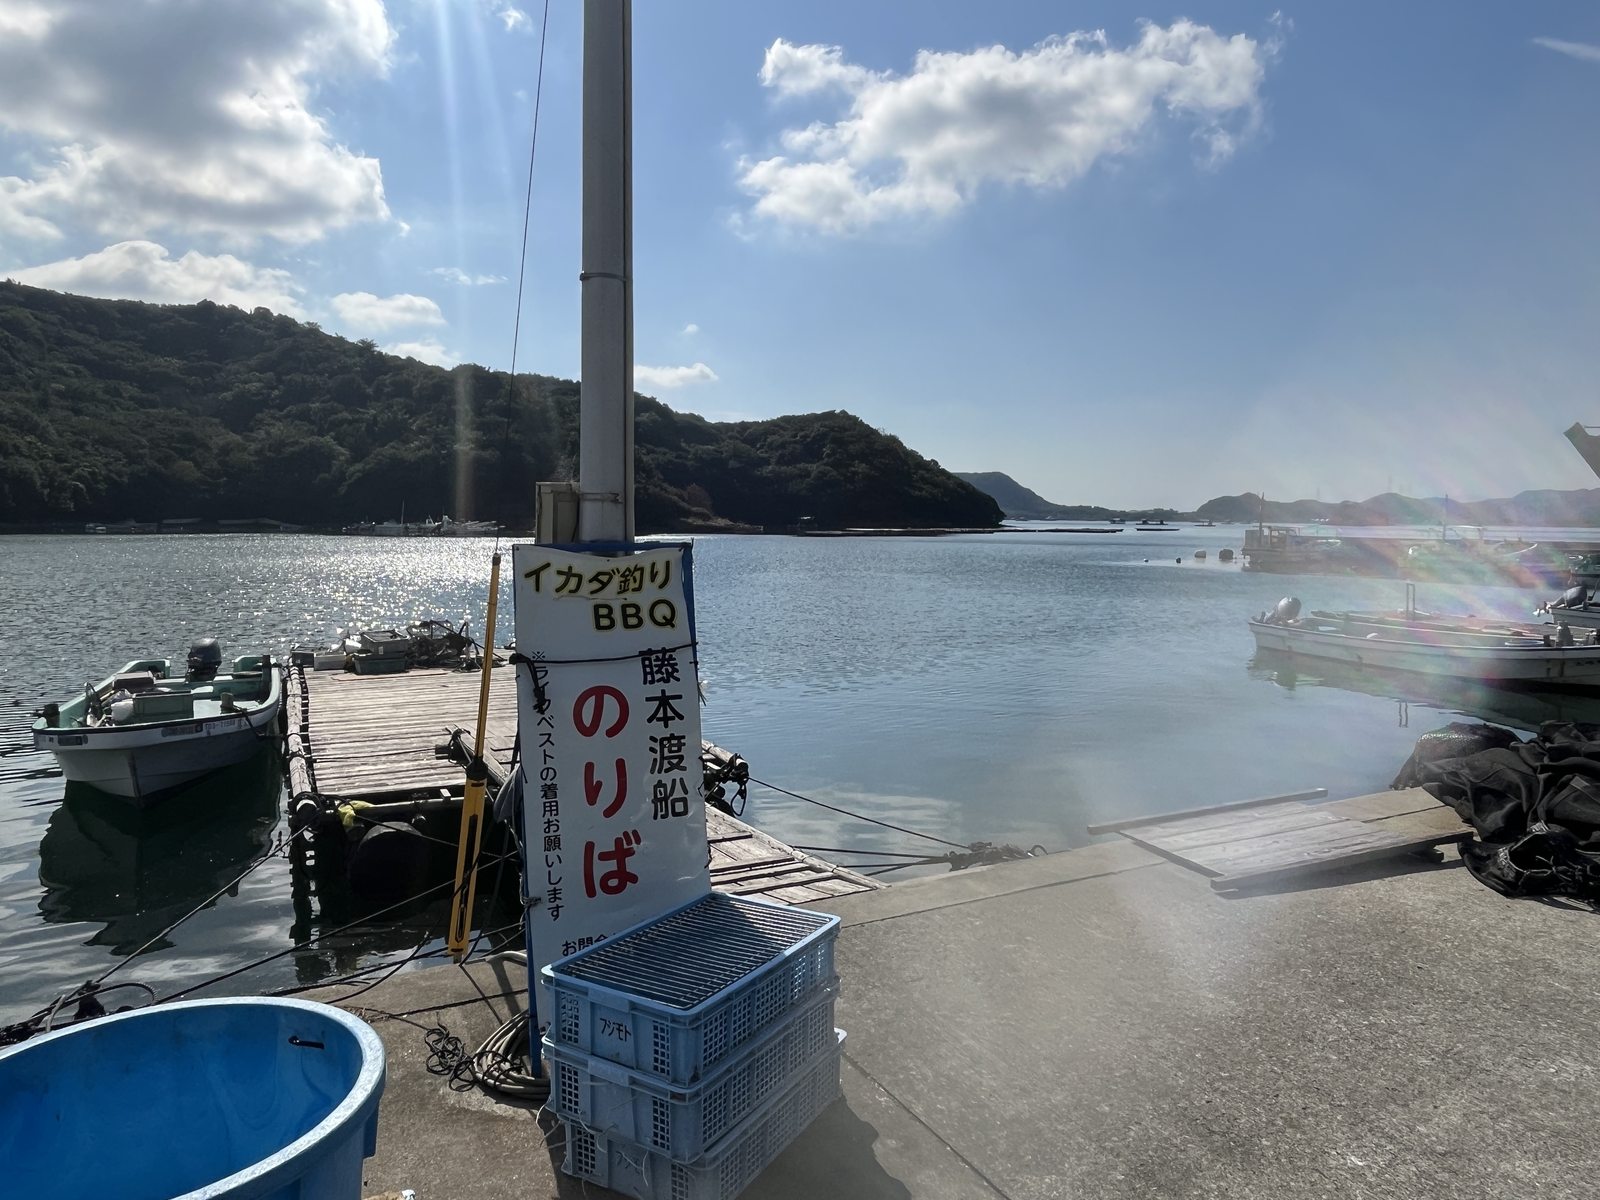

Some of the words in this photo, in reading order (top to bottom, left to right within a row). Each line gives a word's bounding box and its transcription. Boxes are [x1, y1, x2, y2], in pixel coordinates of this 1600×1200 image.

[524, 560, 671, 595] イカダ釣り
[593, 599, 676, 630] BBQ
[638, 646, 689, 820] 藤本渡船
[573, 685, 642, 899] のりば
[599, 1017, 632, 1043] フジモト
